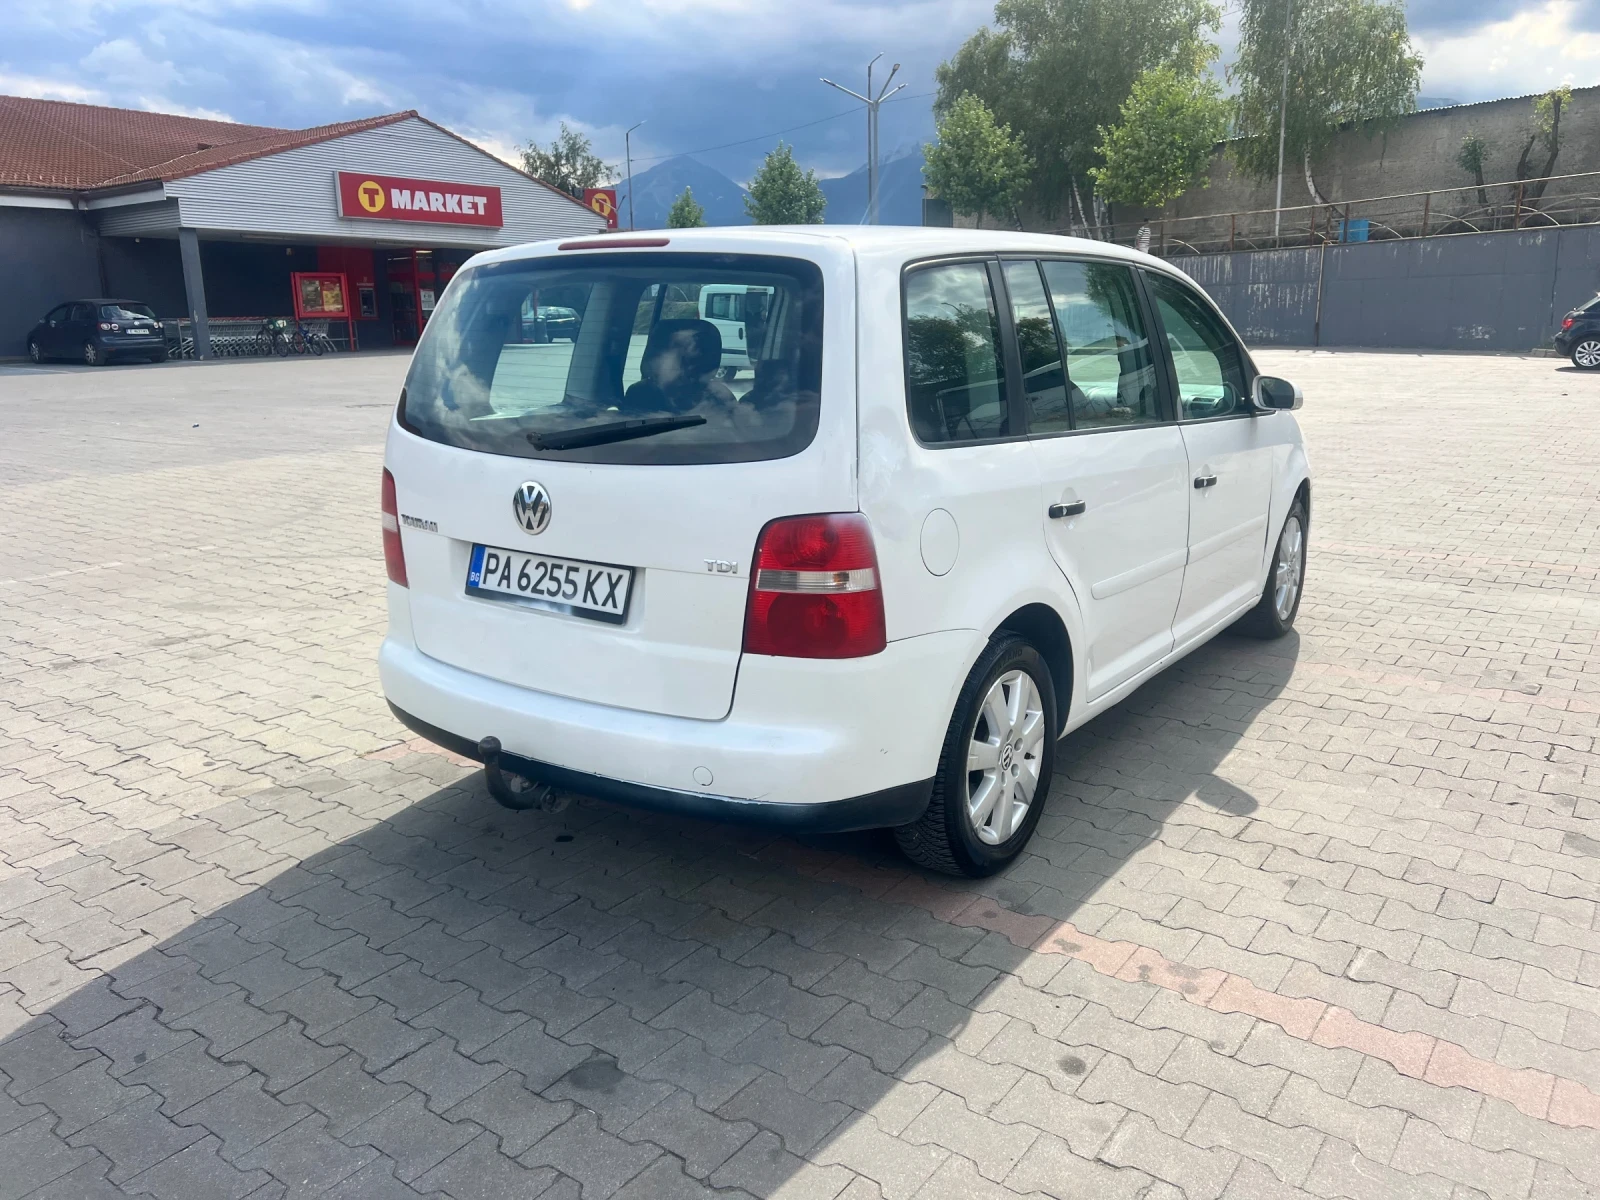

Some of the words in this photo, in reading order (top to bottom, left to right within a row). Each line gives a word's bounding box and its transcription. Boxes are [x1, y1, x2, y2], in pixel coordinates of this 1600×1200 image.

[363, 187, 380, 208] T
[390, 188, 487, 216] MARKET
[703, 558, 738, 575] TDI
[470, 571, 480, 582] BG
